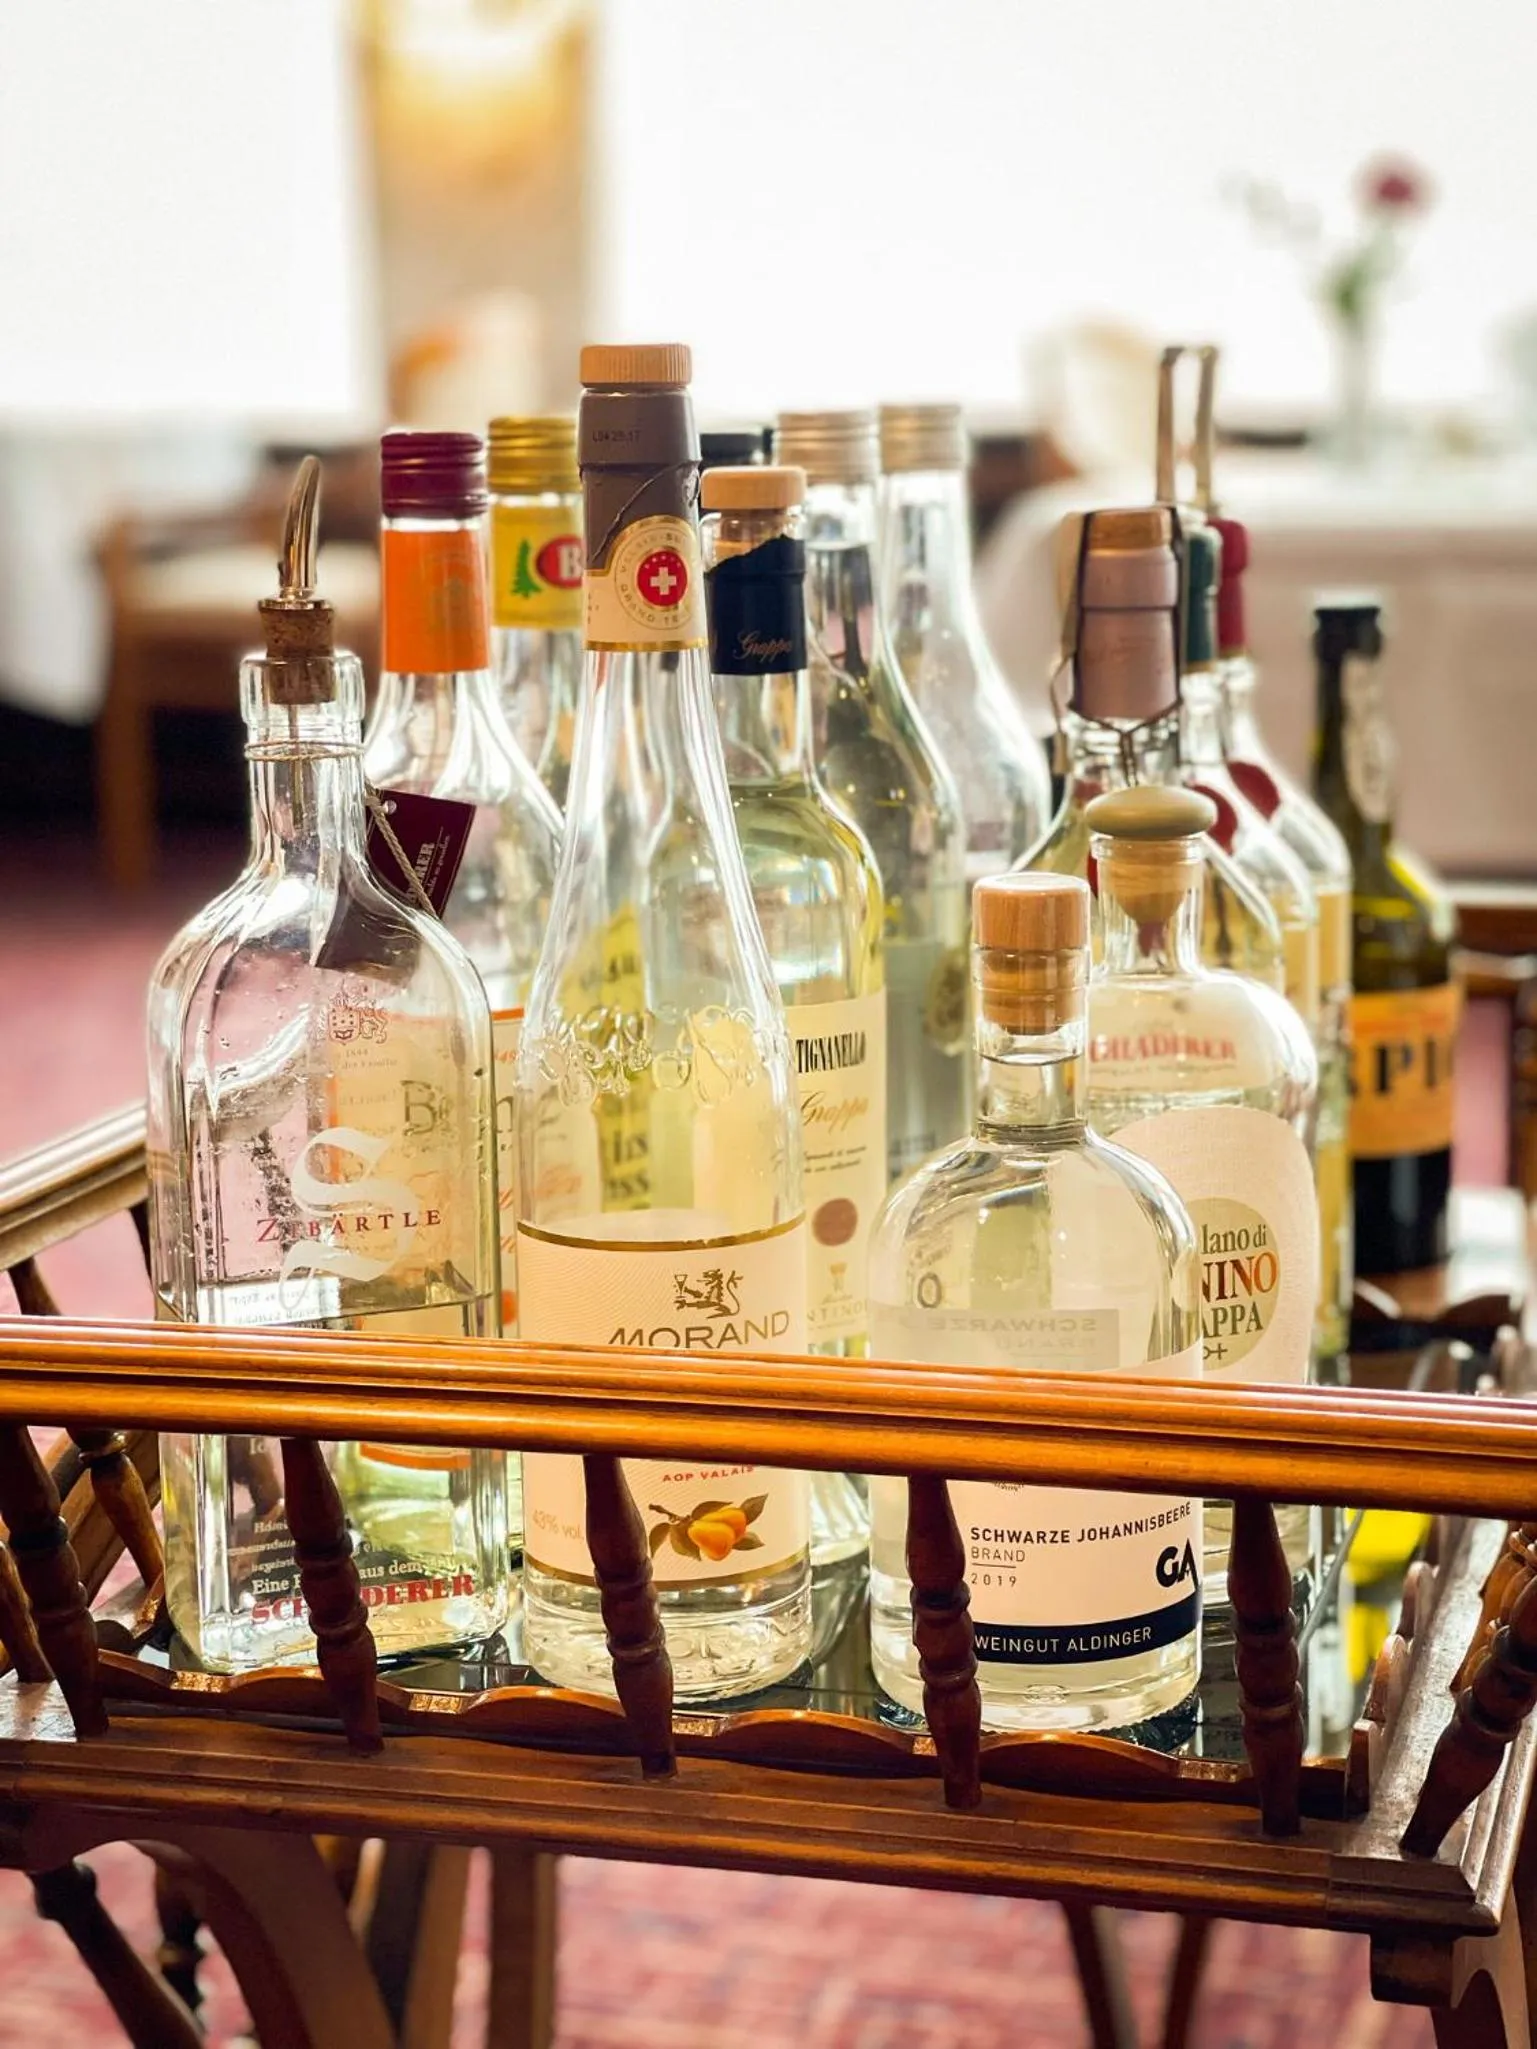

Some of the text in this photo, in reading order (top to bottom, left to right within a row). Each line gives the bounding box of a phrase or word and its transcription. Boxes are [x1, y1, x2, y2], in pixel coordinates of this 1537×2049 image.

[796, 1031, 867, 1074] TIGNANELLO
[1253, 1224, 1267, 1248] di
[608, 1310, 790, 1349] MORAND
[662, 1473, 695, 1482] AOP
[970, 1501, 1192, 1543] SCHWARZE JOHANNISBEERE
[971, 1546, 1026, 1563] BRAND
[252, 1575, 297, 1595] Eine
[971, 1572, 1018, 1588] 2019
[975, 1625, 1152, 1653] WEINGUT ALDINGER
